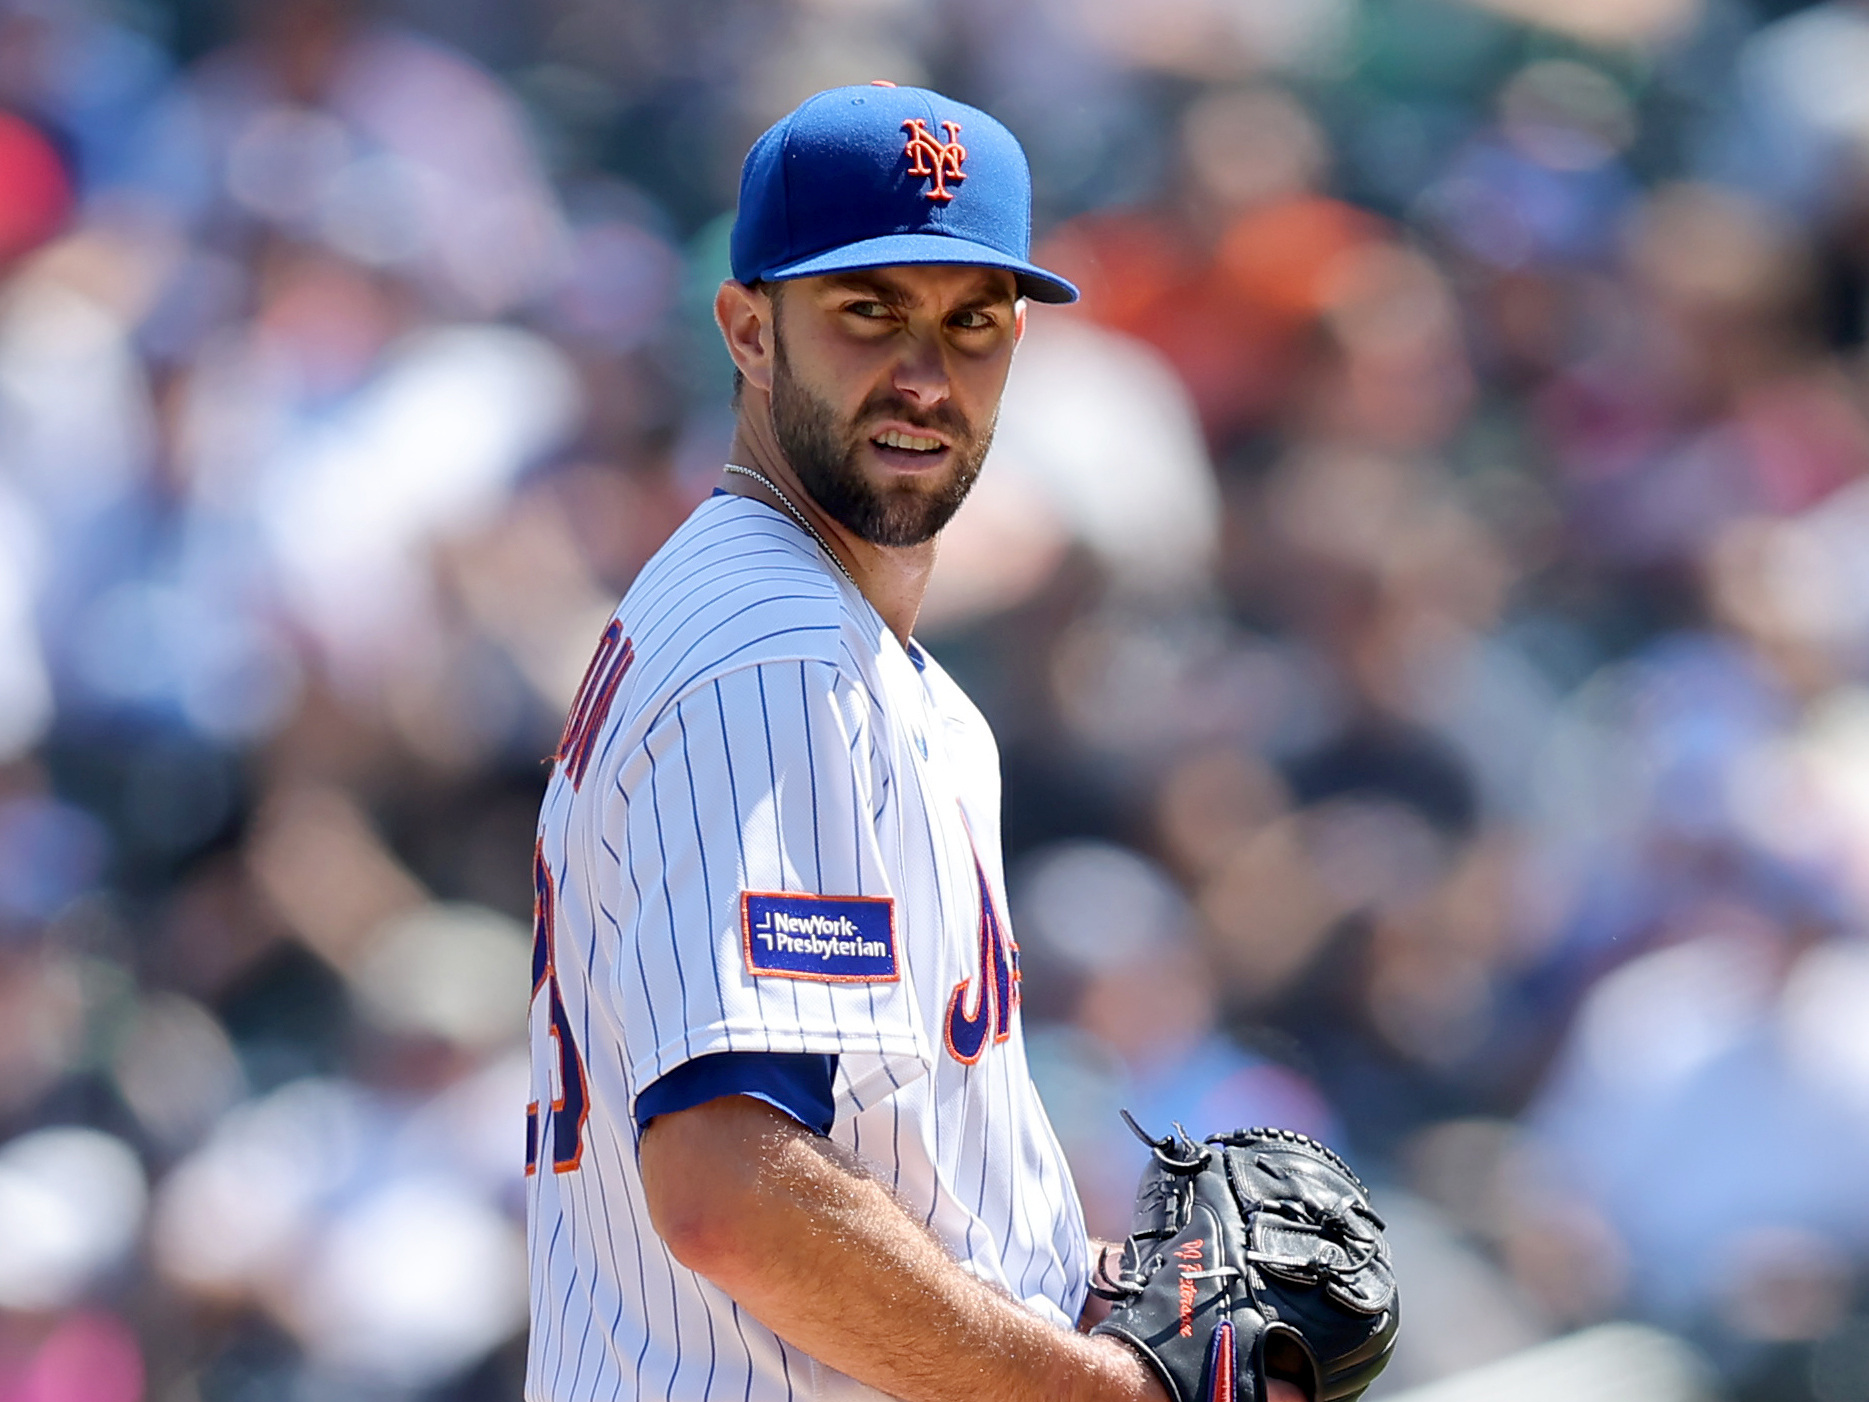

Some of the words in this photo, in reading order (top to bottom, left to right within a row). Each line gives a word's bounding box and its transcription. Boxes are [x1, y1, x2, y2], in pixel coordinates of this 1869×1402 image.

[902, 118, 968, 200] NY
[773, 911, 859, 936] NewYork-
[775, 932, 887, 960] Presbyterian
